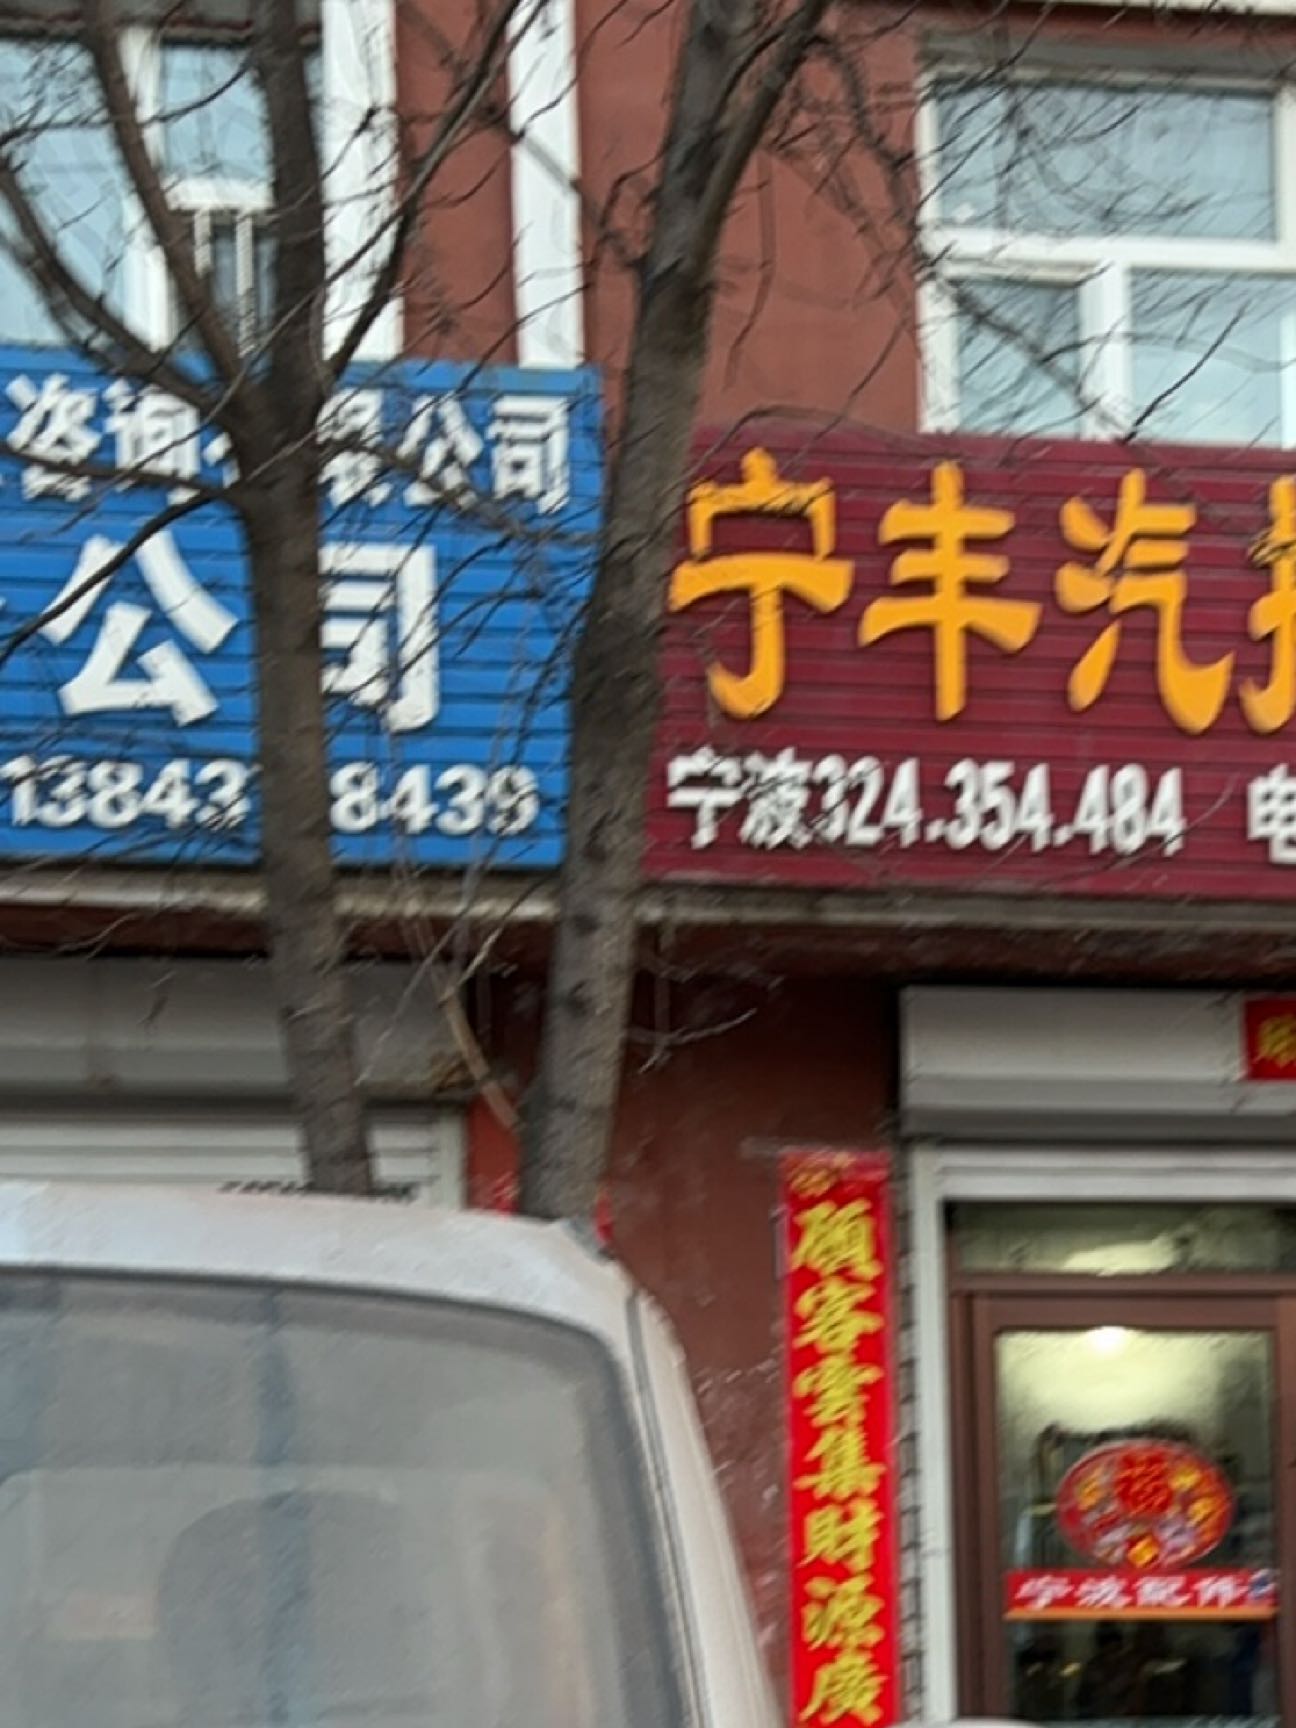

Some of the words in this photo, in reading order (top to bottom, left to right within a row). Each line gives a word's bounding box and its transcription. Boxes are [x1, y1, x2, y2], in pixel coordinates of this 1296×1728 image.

[5, 372, 571, 514] 咨询限公司
[38, 528, 441, 734] 公司
